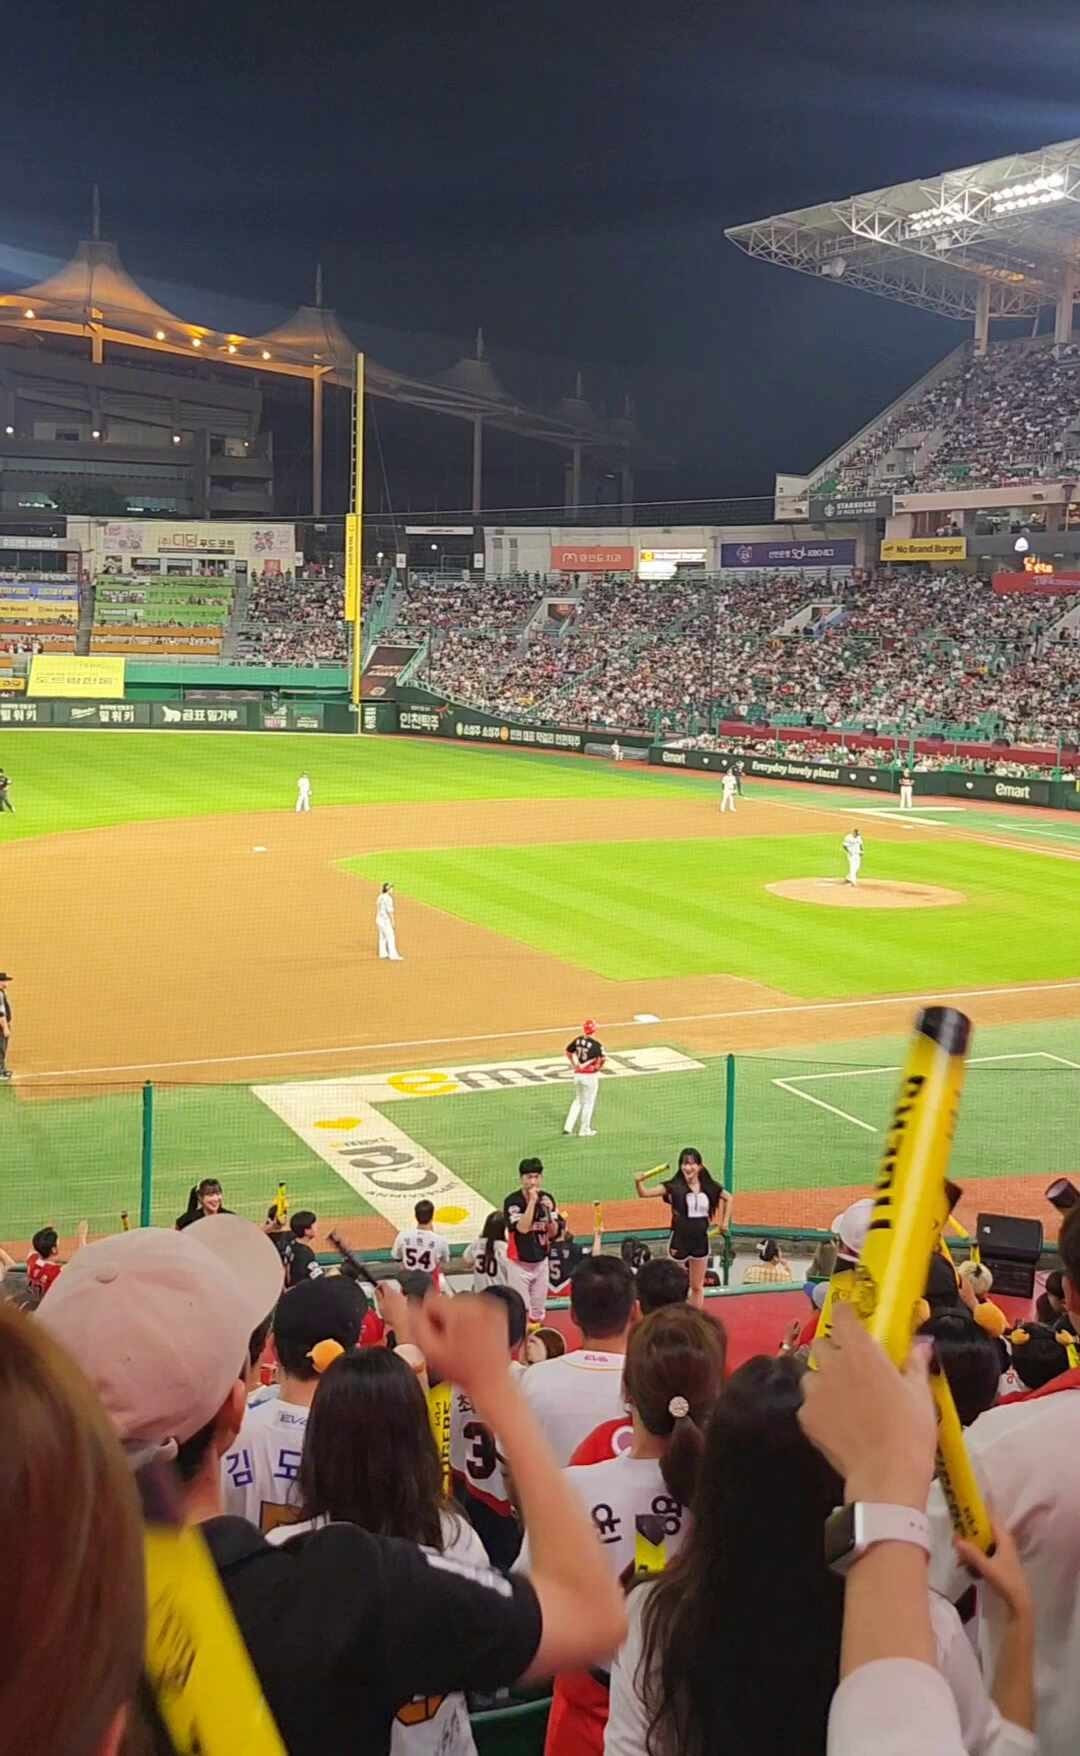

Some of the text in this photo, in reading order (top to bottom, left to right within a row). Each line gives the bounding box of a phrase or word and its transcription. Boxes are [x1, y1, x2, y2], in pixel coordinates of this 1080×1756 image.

[896, 544, 961, 555] No Brand Burger
[99, 710, 134, 722] 밀워키
[183, 709, 238, 722] 곰표 밀가루
[752, 760, 839, 779] Everyday lovely place!
[995, 783, 1031, 799] emart
[406, 1248, 431, 1269] 54
[476, 1254, 498, 1277] 30
